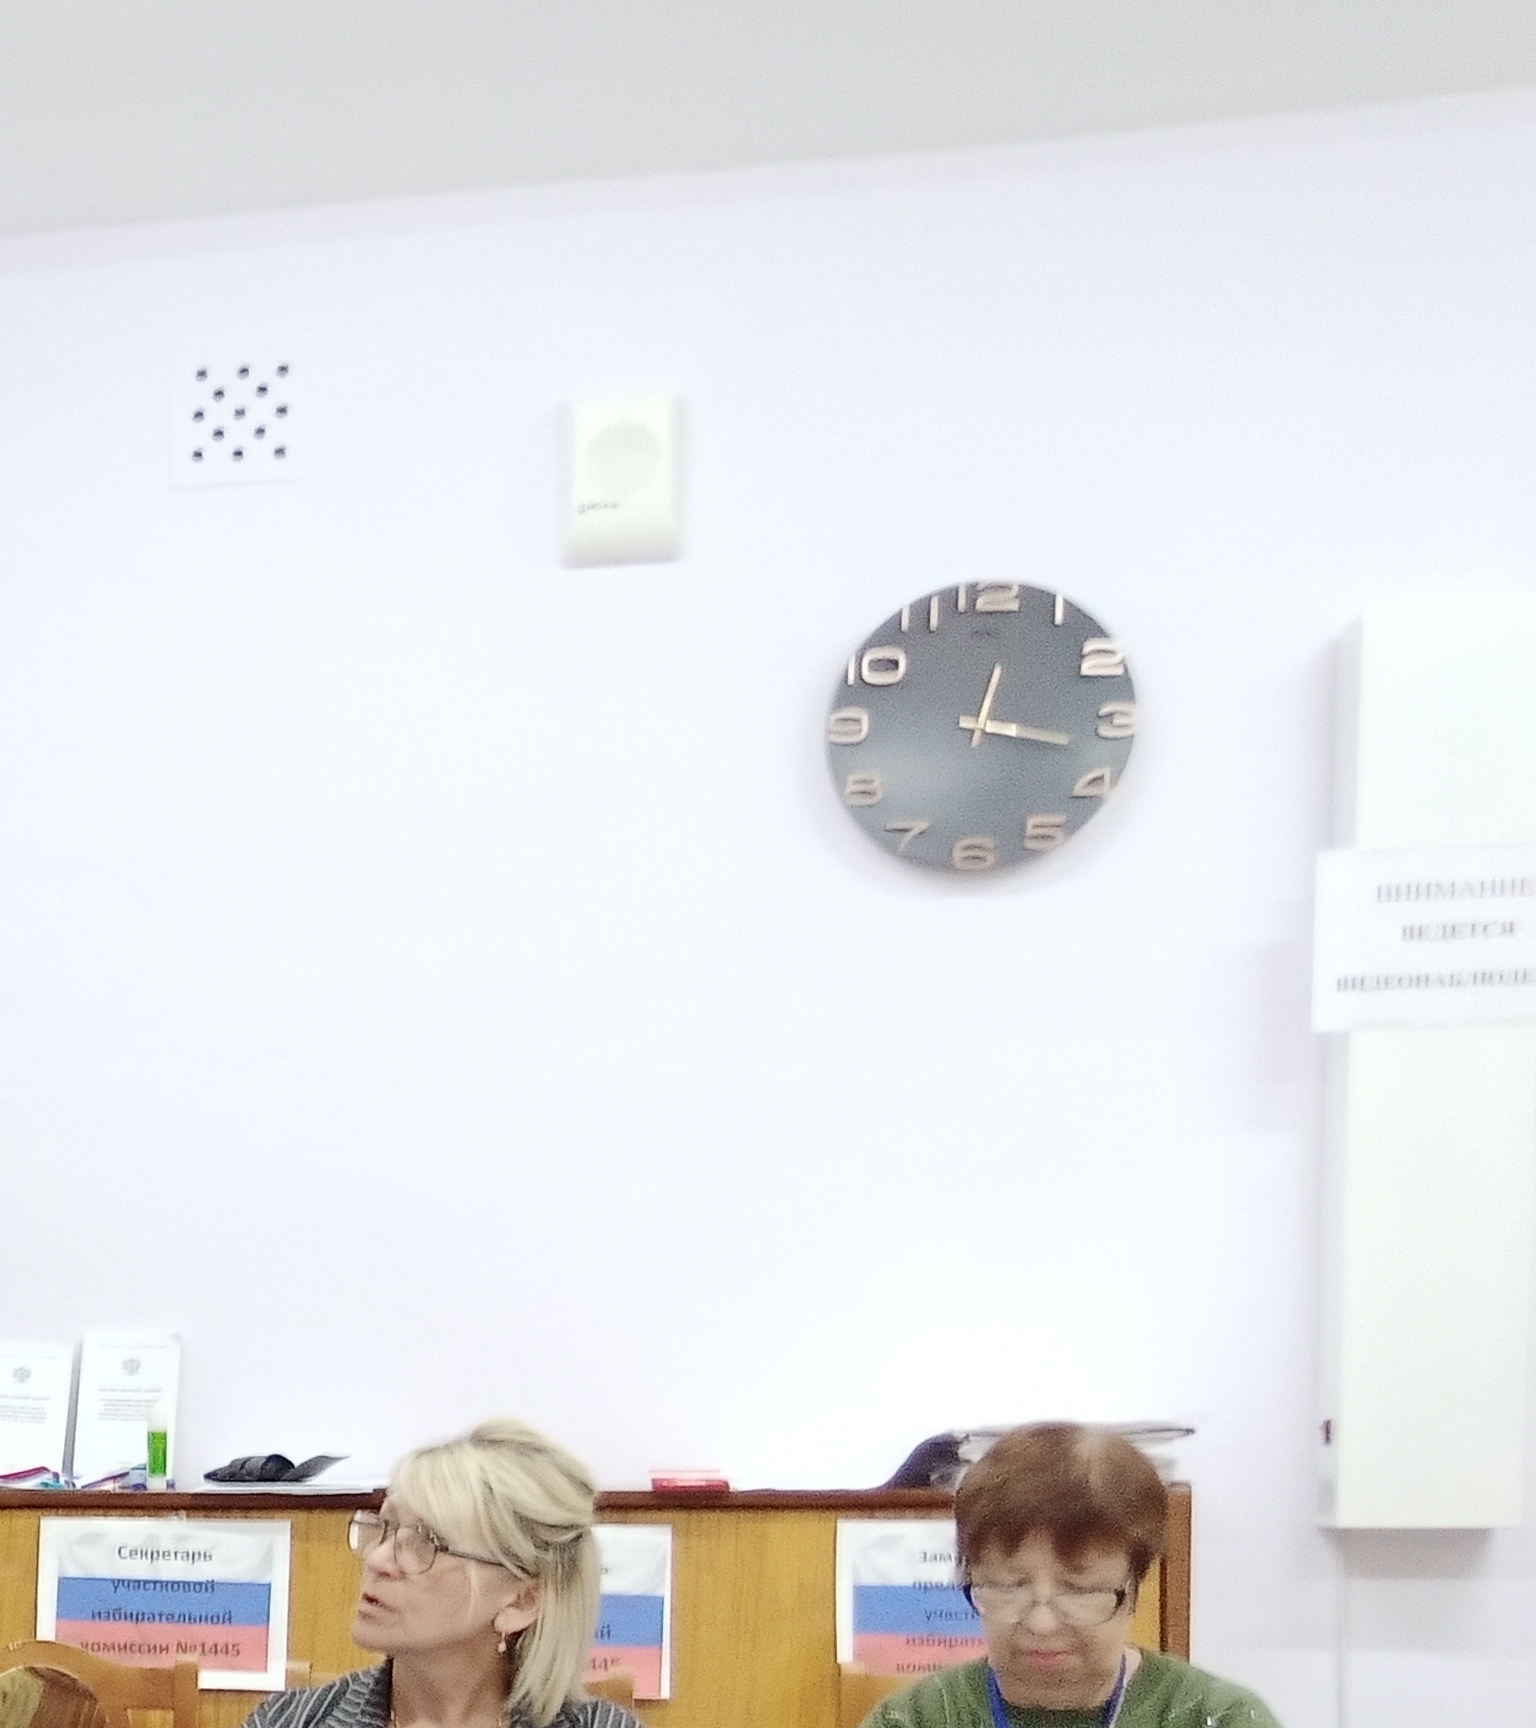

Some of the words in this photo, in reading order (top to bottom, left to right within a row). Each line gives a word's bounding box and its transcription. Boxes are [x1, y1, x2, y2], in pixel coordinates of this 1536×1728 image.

[845, 645, 907, 687] 10
[1079, 635, 1125, 678] 2
[829, 706, 870, 745] 9
[1096, 702, 1138, 739] 3
[843, 769, 882, 807] 8
[1070, 766, 1112, 800] 4
[883, 820, 930, 851] 7
[1024, 814, 1067, 851] 5
[1375, 874, 1536, 904] ВНИМАНИЕ
[1401, 919, 1516, 943] ВЕДЕТСЯ
[1335, 966, 1536, 993] ВИДЕОНАБЛЮДЕ
[117, 1545, 214, 1565] Секретарь
[111, 1579, 216, 1594] участковой
[90, 1608, 234, 1626] избирательной
[80, 1640, 170, 1655] комиссии
[175, 1641, 241, 1657] №1445
